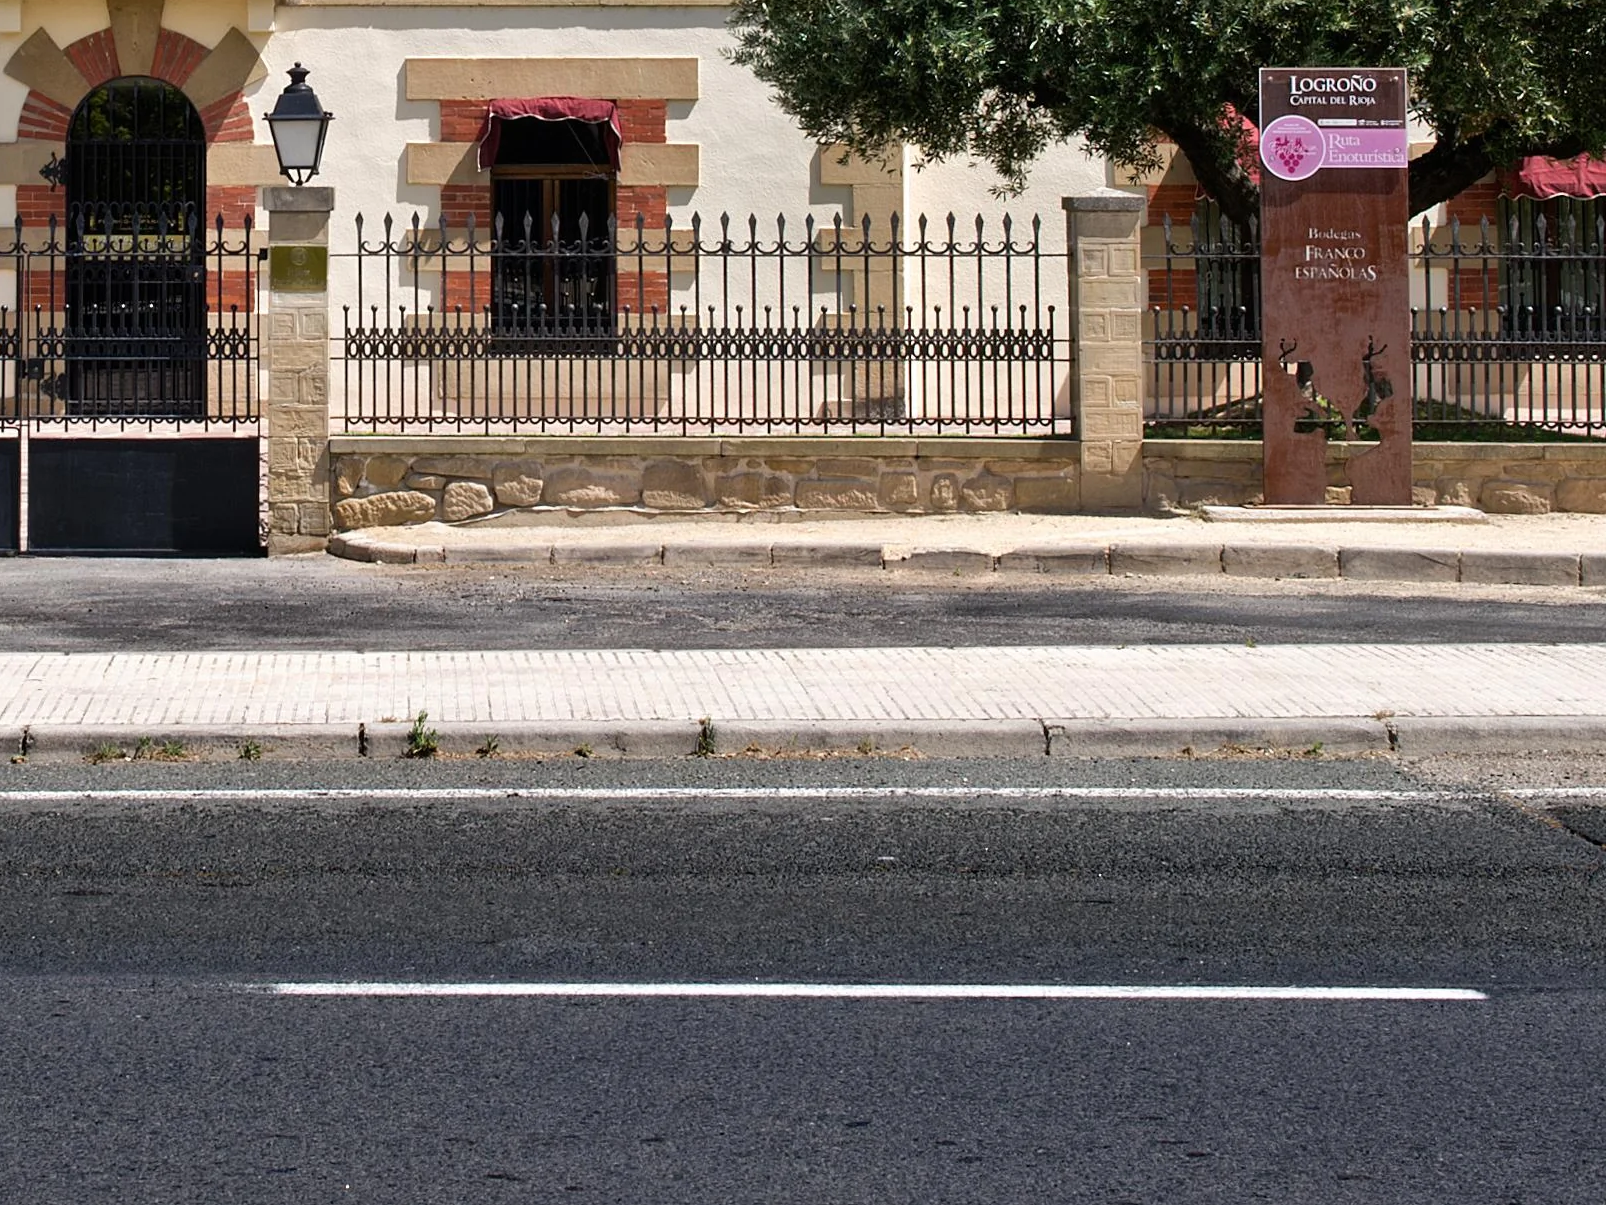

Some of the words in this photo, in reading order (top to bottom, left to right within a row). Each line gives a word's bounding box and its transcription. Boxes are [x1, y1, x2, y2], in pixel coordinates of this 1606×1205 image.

[1289, 74, 1377, 95] LOGROÑO
[1289, 95, 1327, 106] CAPITAL
[1329, 96, 1346, 105] DEL
[1349, 95, 1376, 106] RIOJA
[1328, 133, 1361, 149] Ruta
[1328, 148, 1406, 163] Enoturística
[1308, 227, 1362, 240] Bodegas
[1305, 244, 1366, 262] FRANCO
[1295, 263, 1377, 282] ESPAÑOLAS
